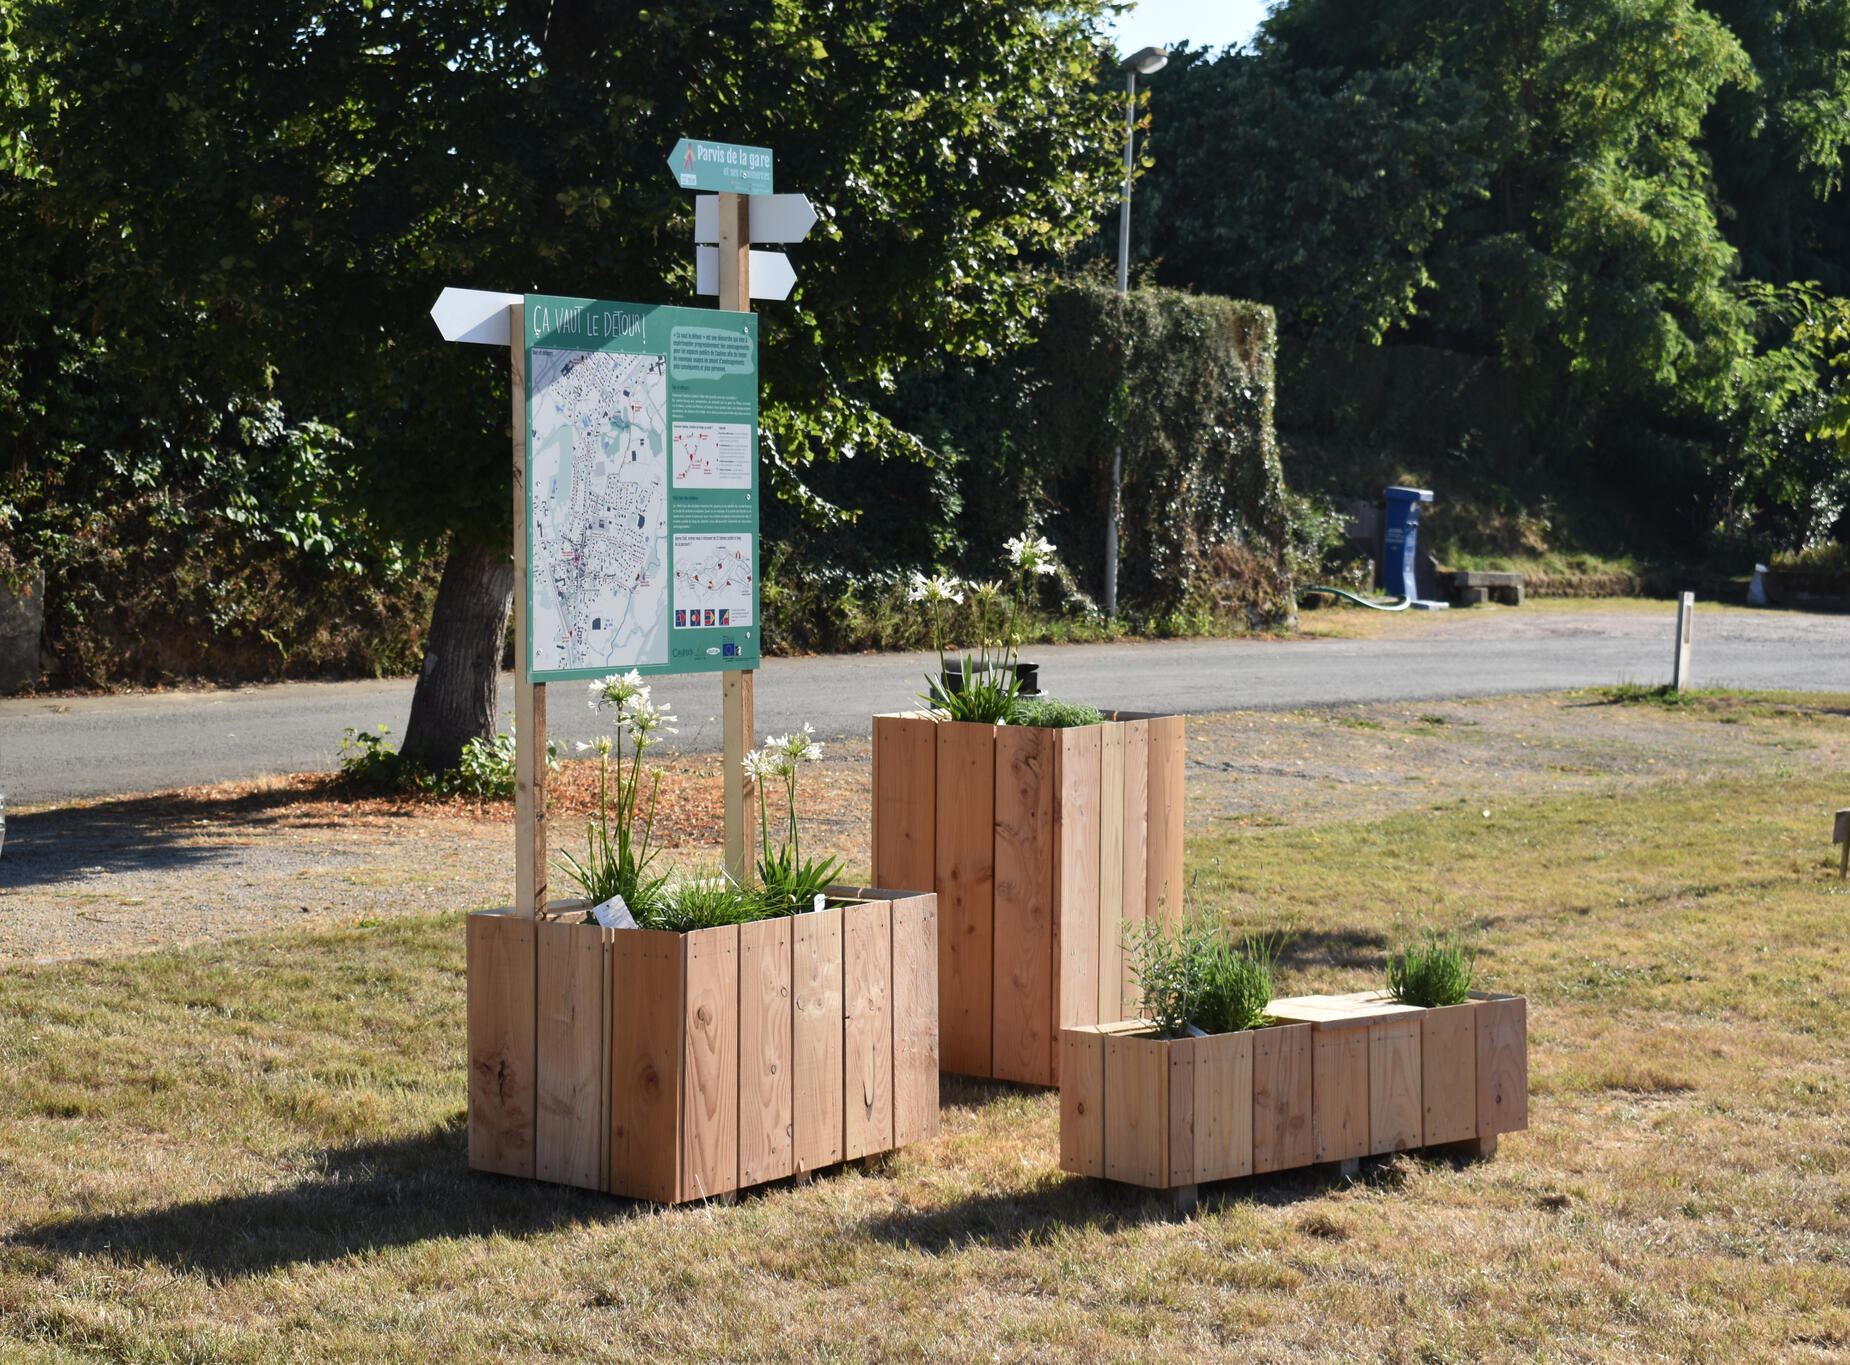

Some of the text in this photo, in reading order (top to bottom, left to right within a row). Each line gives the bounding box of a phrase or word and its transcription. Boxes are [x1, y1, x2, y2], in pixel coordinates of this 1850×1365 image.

[697, 144, 770, 169] Parvis de la gare
[739, 169, 770, 180] cmmerces
[533, 305, 550, 338] ÇA
[554, 306, 584, 334] VAUT
[586, 311, 599, 337] LE
